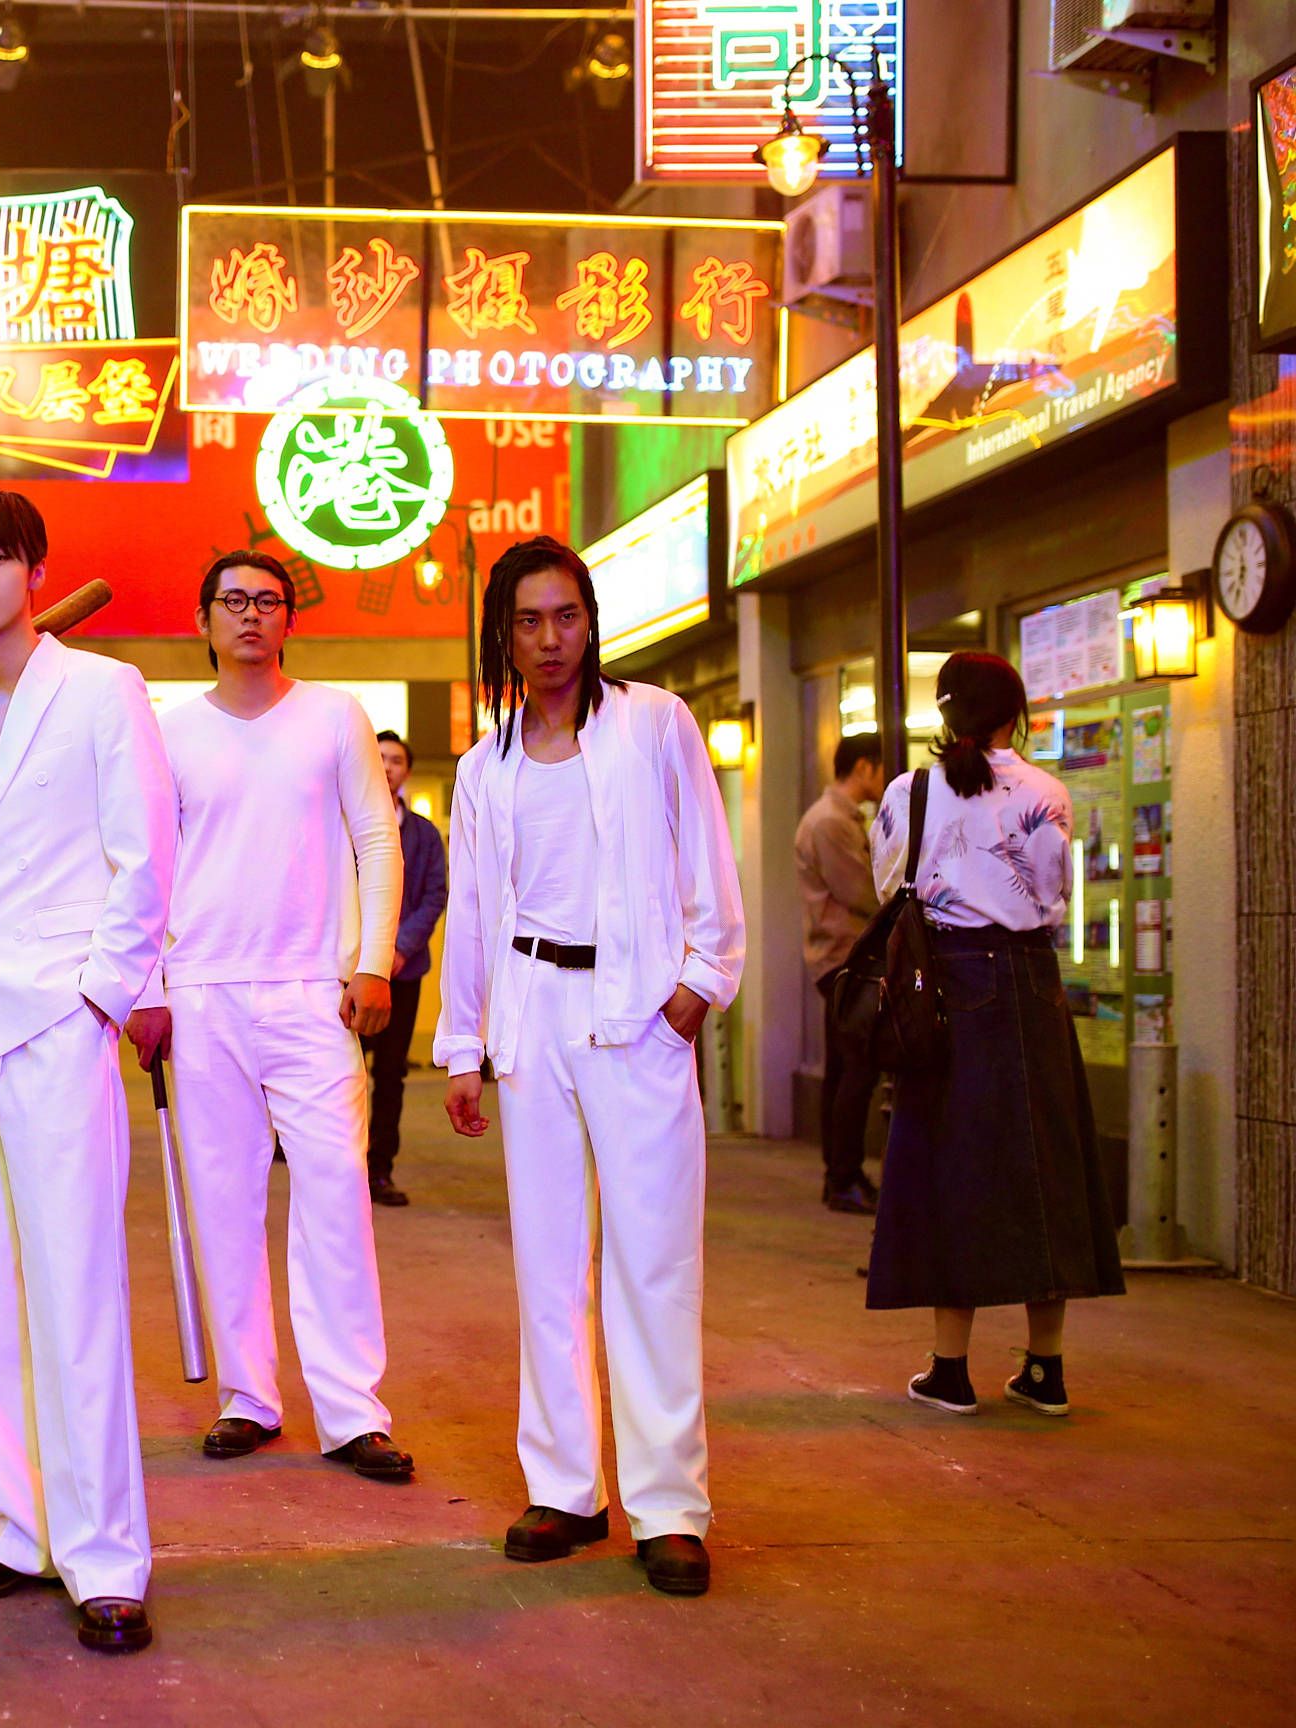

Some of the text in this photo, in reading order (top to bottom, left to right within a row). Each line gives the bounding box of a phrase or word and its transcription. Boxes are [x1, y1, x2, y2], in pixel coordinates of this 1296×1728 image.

[208, 238, 770, 349] 婚纱摄影行
[198, 341, 754, 393] WEDDING PHOTOGRAPHY
[485, 403, 555, 448] Use
[966, 354, 1166, 465] International Travel Agency
[468, 487, 541, 533] and
